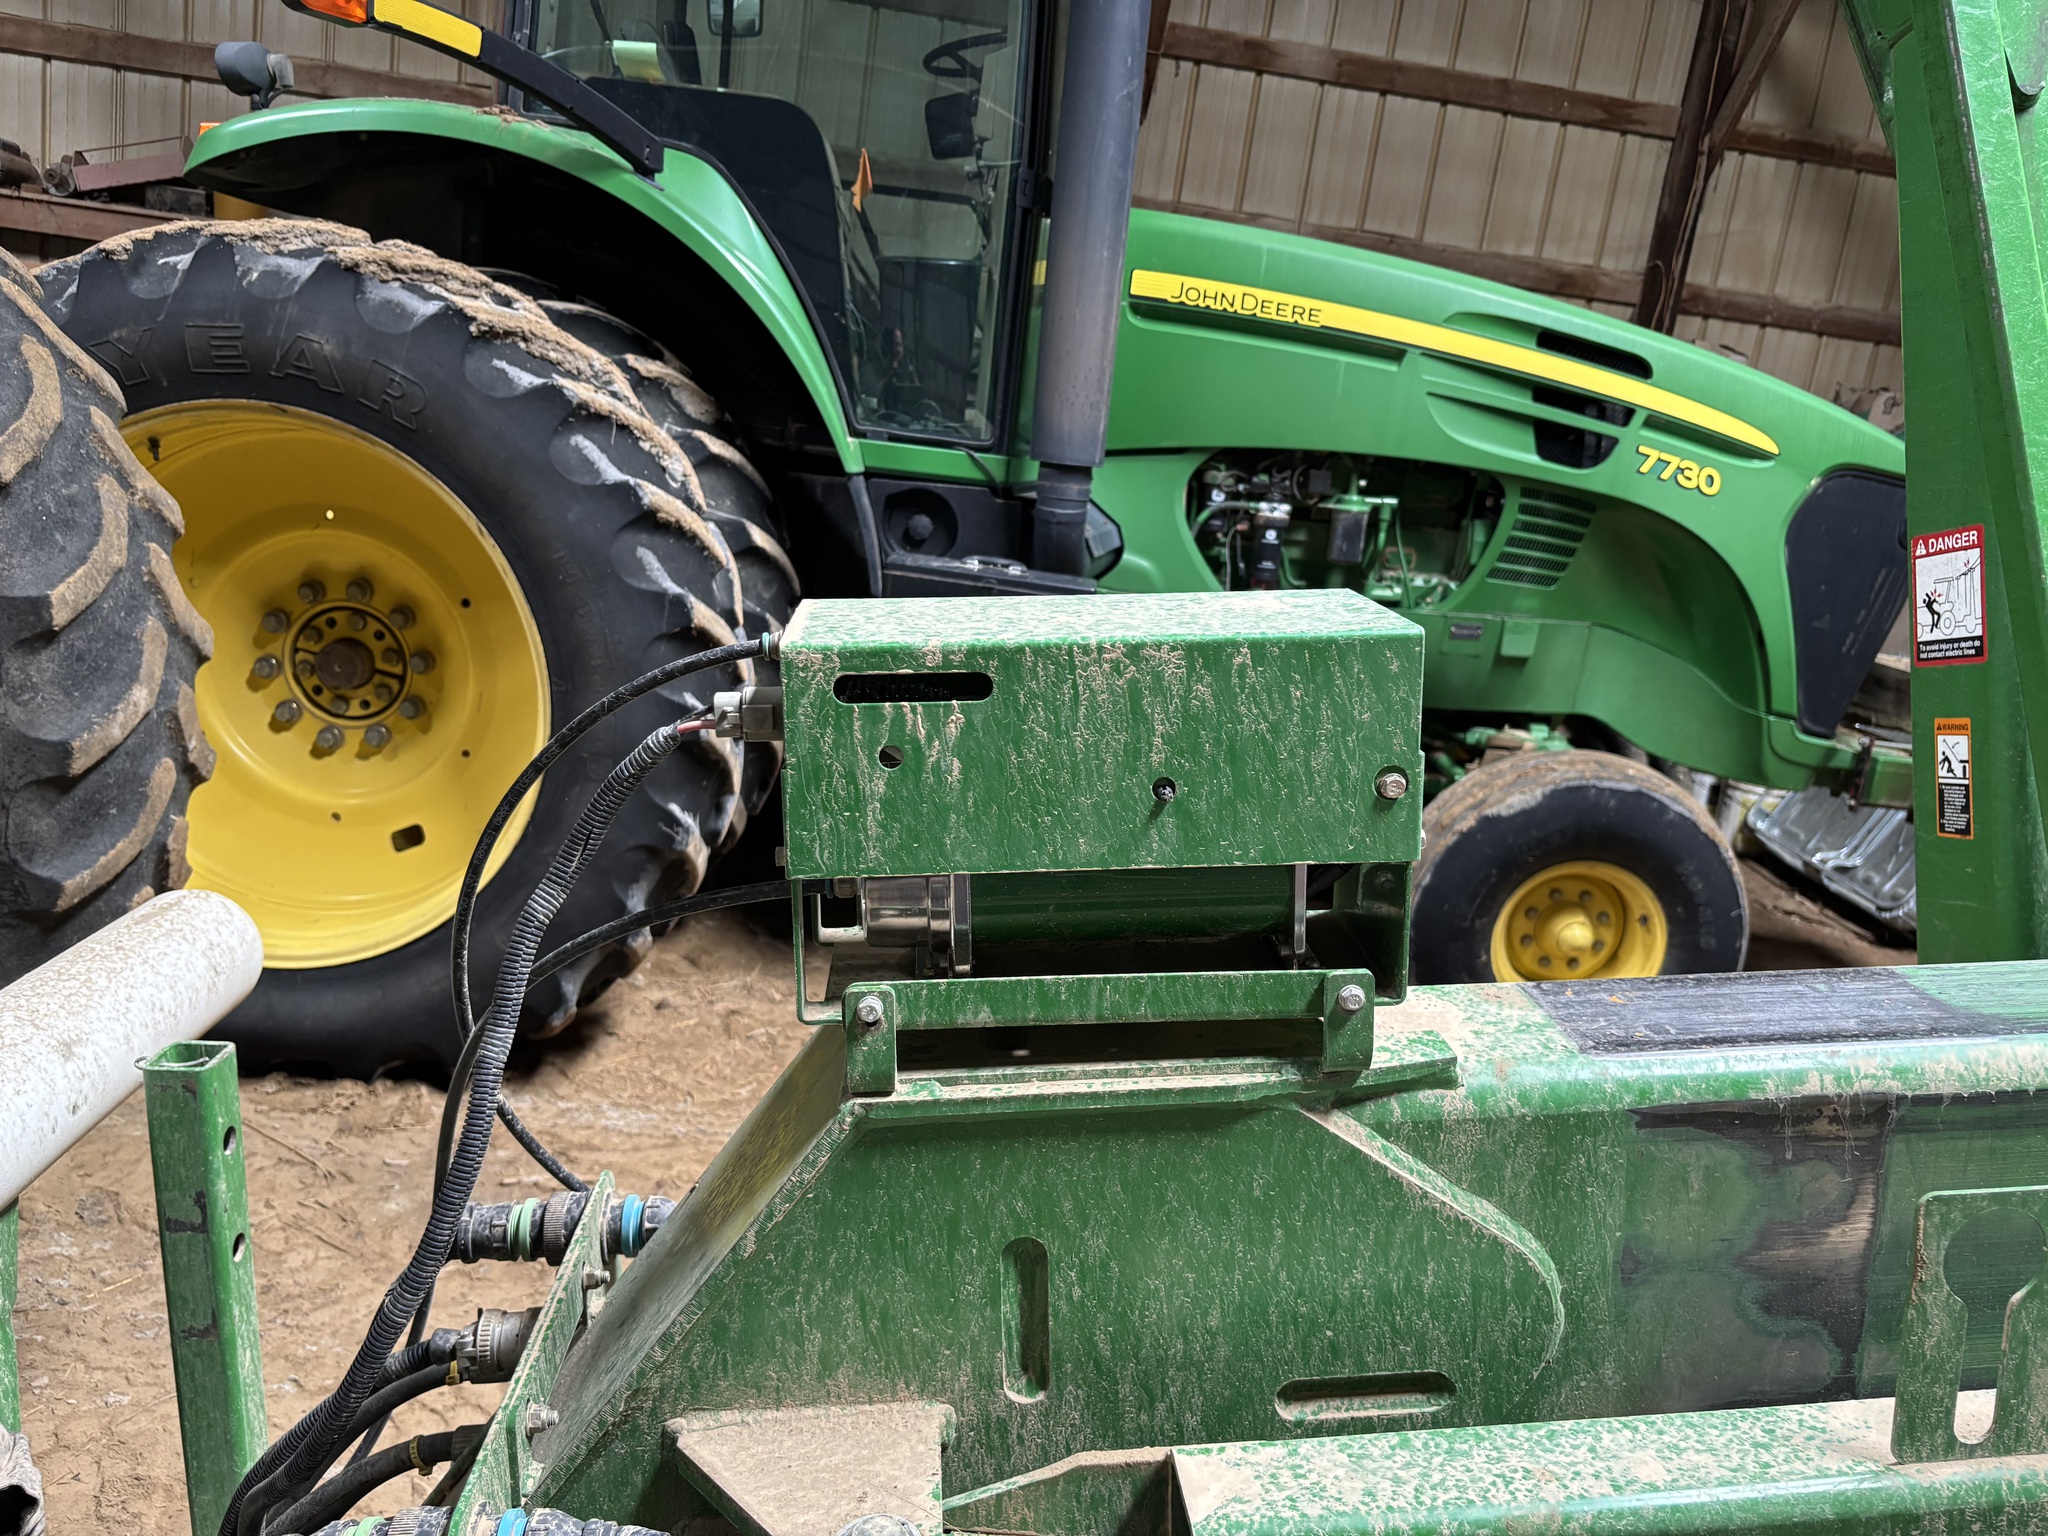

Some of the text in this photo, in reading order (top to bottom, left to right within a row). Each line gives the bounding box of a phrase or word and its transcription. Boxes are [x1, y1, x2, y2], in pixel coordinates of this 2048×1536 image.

[1170, 281, 1322, 324] JOHN DEERE
[1637, 444, 1722, 497] 7730
[1928, 530, 1978, 553] DANGER
[1919, 651, 1928, 659] not
[1927, 650, 1945, 659] contact
[1945, 648, 1963, 657] electric
[1926, 643, 1939, 651] avoid
[1939, 642, 1953, 650] injury
[1959, 640, 1973, 649] death
[1973, 639, 1981, 647] do
[1942, 723, 1969, 732] WARNING
[537, 741, 562, 768] HOSE
